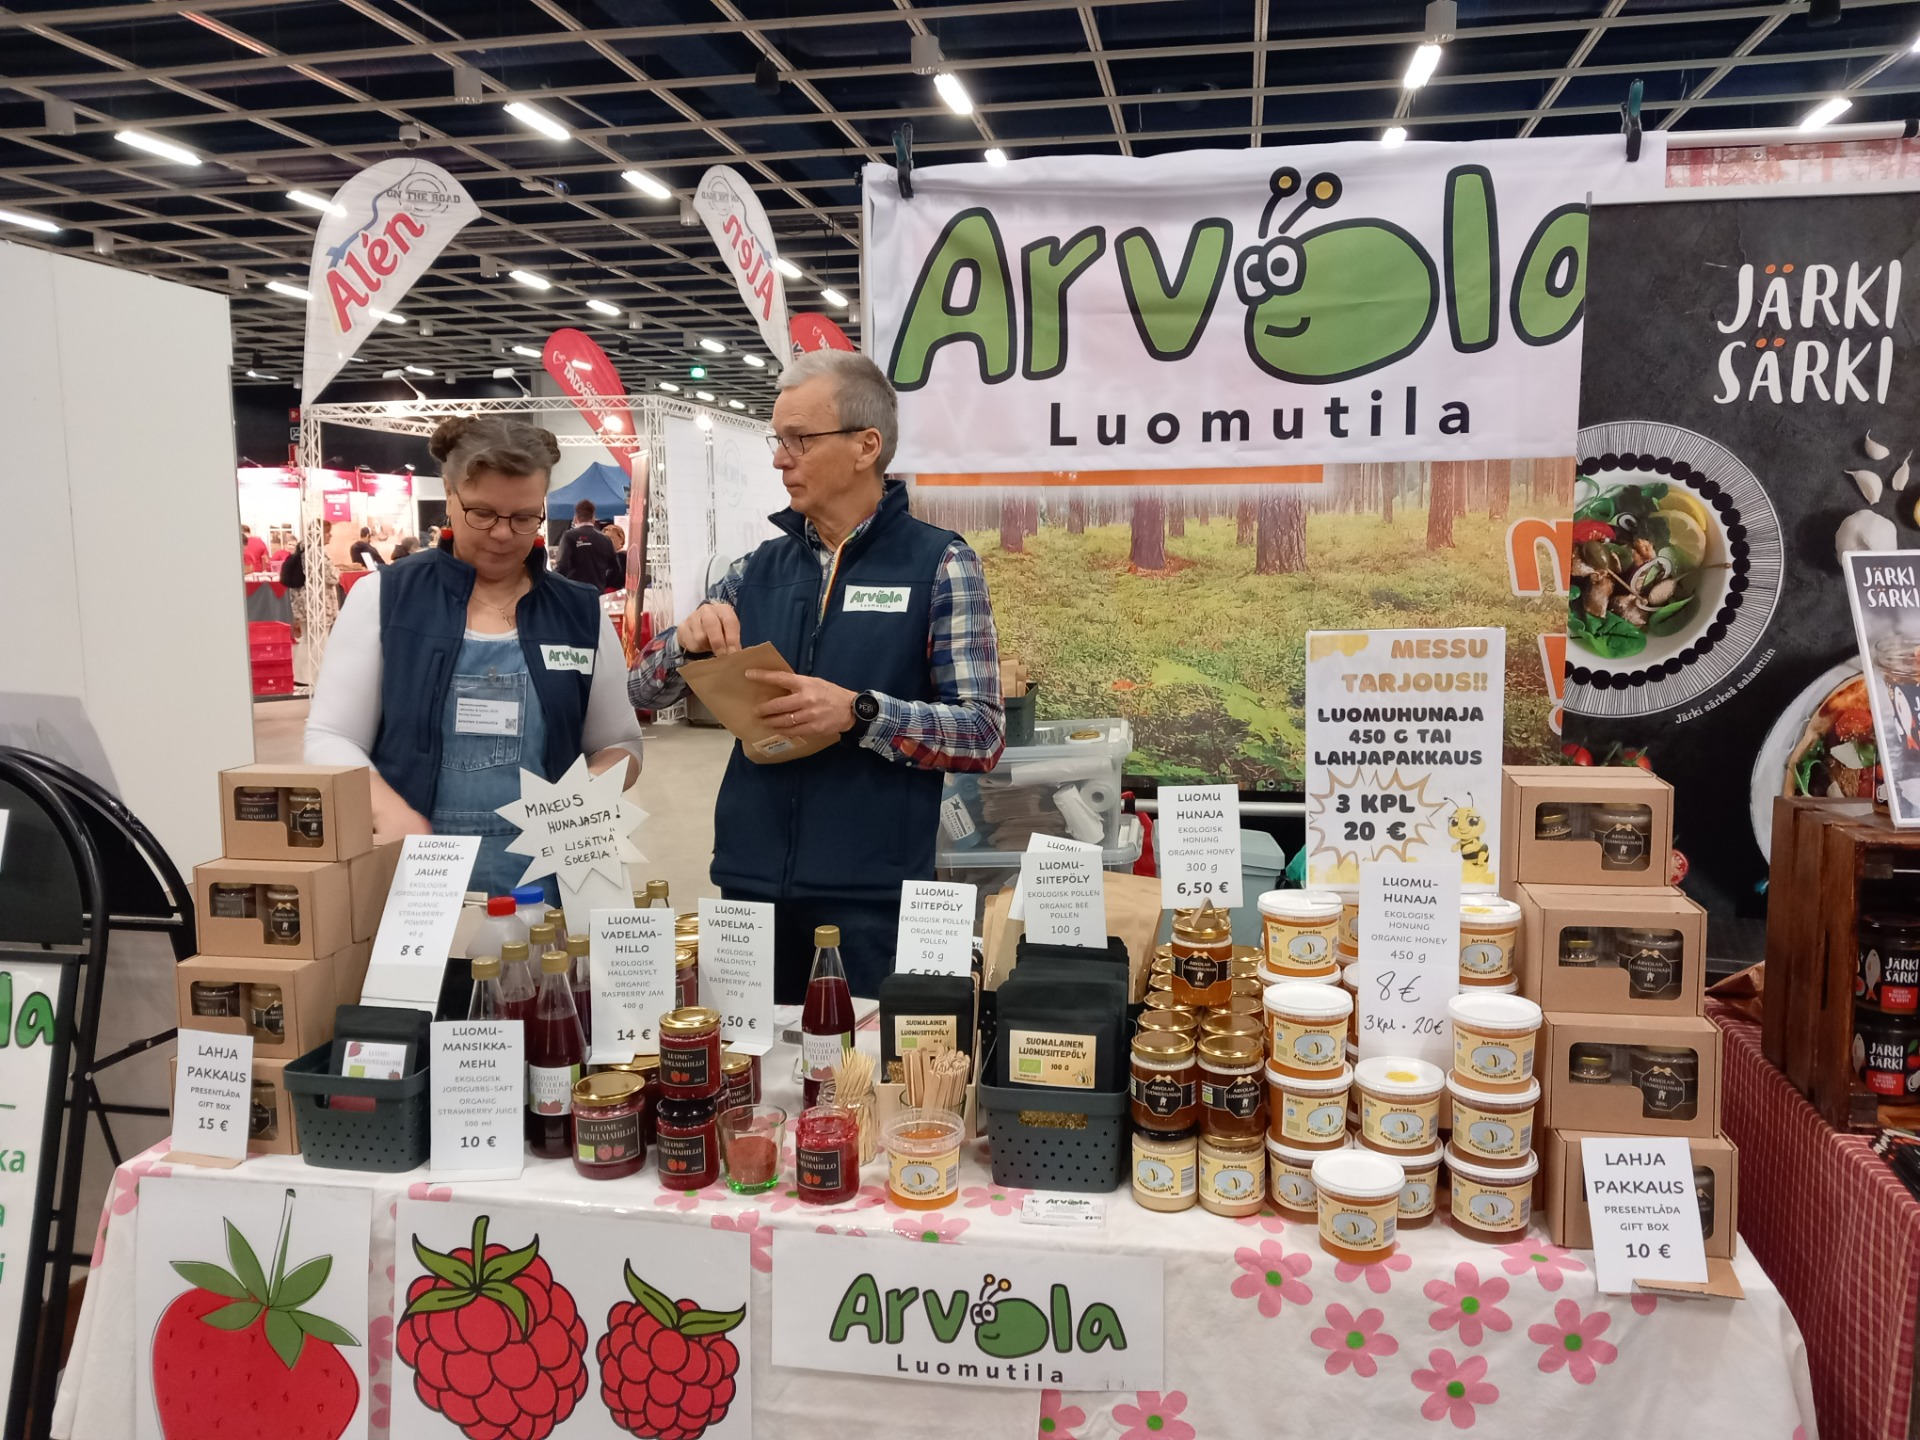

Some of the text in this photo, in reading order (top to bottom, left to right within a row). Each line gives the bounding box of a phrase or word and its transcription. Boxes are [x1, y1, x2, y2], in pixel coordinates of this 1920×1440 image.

[386, 190, 460, 203] ON THE ROAD
[326, 213, 424, 333] Alén
[1717, 259, 1901, 334] JÄRKI
[1713, 336, 1894, 405] SÄRKI
[1050, 386, 1471, 447] Luomutila
[1863, 566, 1915, 588] JÄRKI
[1867, 587, 1920, 609] SÄRKI
[1391, 638, 1489, 660] MESSU
[1341, 672, 1489, 693] TARJOUS!!
[1675, 648, 1776, 724] Järki särkeä salaattiin
[1317, 706, 1484, 723] LUOMUHUNAJA
[1349, 728, 1451, 744] 450 G TAI
[1314, 750, 1483, 766] LAHJAPAKKAUS
[1177, 793, 1221, 802] LUOMU
[524, 794, 584, 818] MAKEUS
[1335, 794, 1415, 814] 3 KPL
[1176, 810, 1224, 820] HUNAJA
[1344, 821, 1407, 841] 20 €
[418, 841, 461, 849] LUOMU-
[541, 827, 616, 857] EI LISÄTTYÄ
[406, 854, 465, 862] MANSIKKA-
[1206, 848, 1235, 856] HONEY
[1039, 861, 1084, 870] LUOMU-
[1186, 862, 1218, 873] 300 g
[415, 868, 448, 876] JAUHE
[1036, 873, 1090, 884] SIITEPÖLY
[1382, 877, 1439, 889] LUOMU-
[916, 888, 959, 897] LUOMU-
[1177, 881, 1228, 896] 6,50 €
[1383, 893, 1437, 905] HUNAJA
[715, 905, 756, 916] LUOMU-
[910, 901, 963, 911] SIITEPÖLY
[608, 916, 656, 925] LUOMU-
[1384, 911, 1435, 920] EKOLOGISK
[910, 928, 943, 936] ORGANIC
[1051, 925, 1081, 935] 100 g
[1389, 921, 1430, 931] HONUNG
[601, 930, 662, 940] VADELMA-
[721, 933, 750, 943] HILLO
[1371, 934, 1447, 945] ORGANIC HONEY
[400, 945, 424, 956] 8 €
[615, 944, 649, 953] HILLO
[717, 948, 754, 957] EKOLOGISK
[714, 957, 756, 967] HALLONSYLT
[922, 951, 944, 962] 50 g
[1390, 951, 1426, 963] 450 g
[1885, 957, 1919, 970] JÄRKI
[720, 968, 750, 977] ORGANIC
[1885, 970, 1918, 983] SÄRKI
[709, 976, 762, 987] RASPBERRY JAM
[602, 990, 646, 998] RASPBERRY
[719, 1015, 756, 1029] ,50 €
[452, 1027, 503, 1036] LUOMU-
[617, 1028, 651, 1041] 14 €
[442, 1042, 512, 1051] MANSIKKA-
[1026, 1037, 1084, 1049] SUOMALAINEN
[198, 1045, 238, 1060] LAHJA
[1018, 1047, 1087, 1060] LUOMUSIITEPÖLY
[1869, 1042, 1903, 1057] JÄRKI
[459, 1060, 496, 1069] MEHU
[1870, 1055, 1903, 1070] SÄRKI
[187, 1066, 247, 1083] PAKKAUS
[190, 1086, 240, 1099] PRESENTLÅDA
[198, 1101, 231, 1110] GIFT BOX
[198, 1117, 228, 1132] 15 €
[460, 1136, 496, 1148] 10 €
[1605, 1153, 1666, 1166] LAHJA
[1594, 1180, 1684, 1194] PAKKAUS
[1604, 1203, 1680, 1214] PRESENTLÅDA
[1620, 1222, 1670, 1231] GIFT BOX
[1626, 1243, 1671, 1259] 10 €
[828, 1273, 1128, 1360] Arvola
[897, 1354, 1064, 1383] Luomutila
